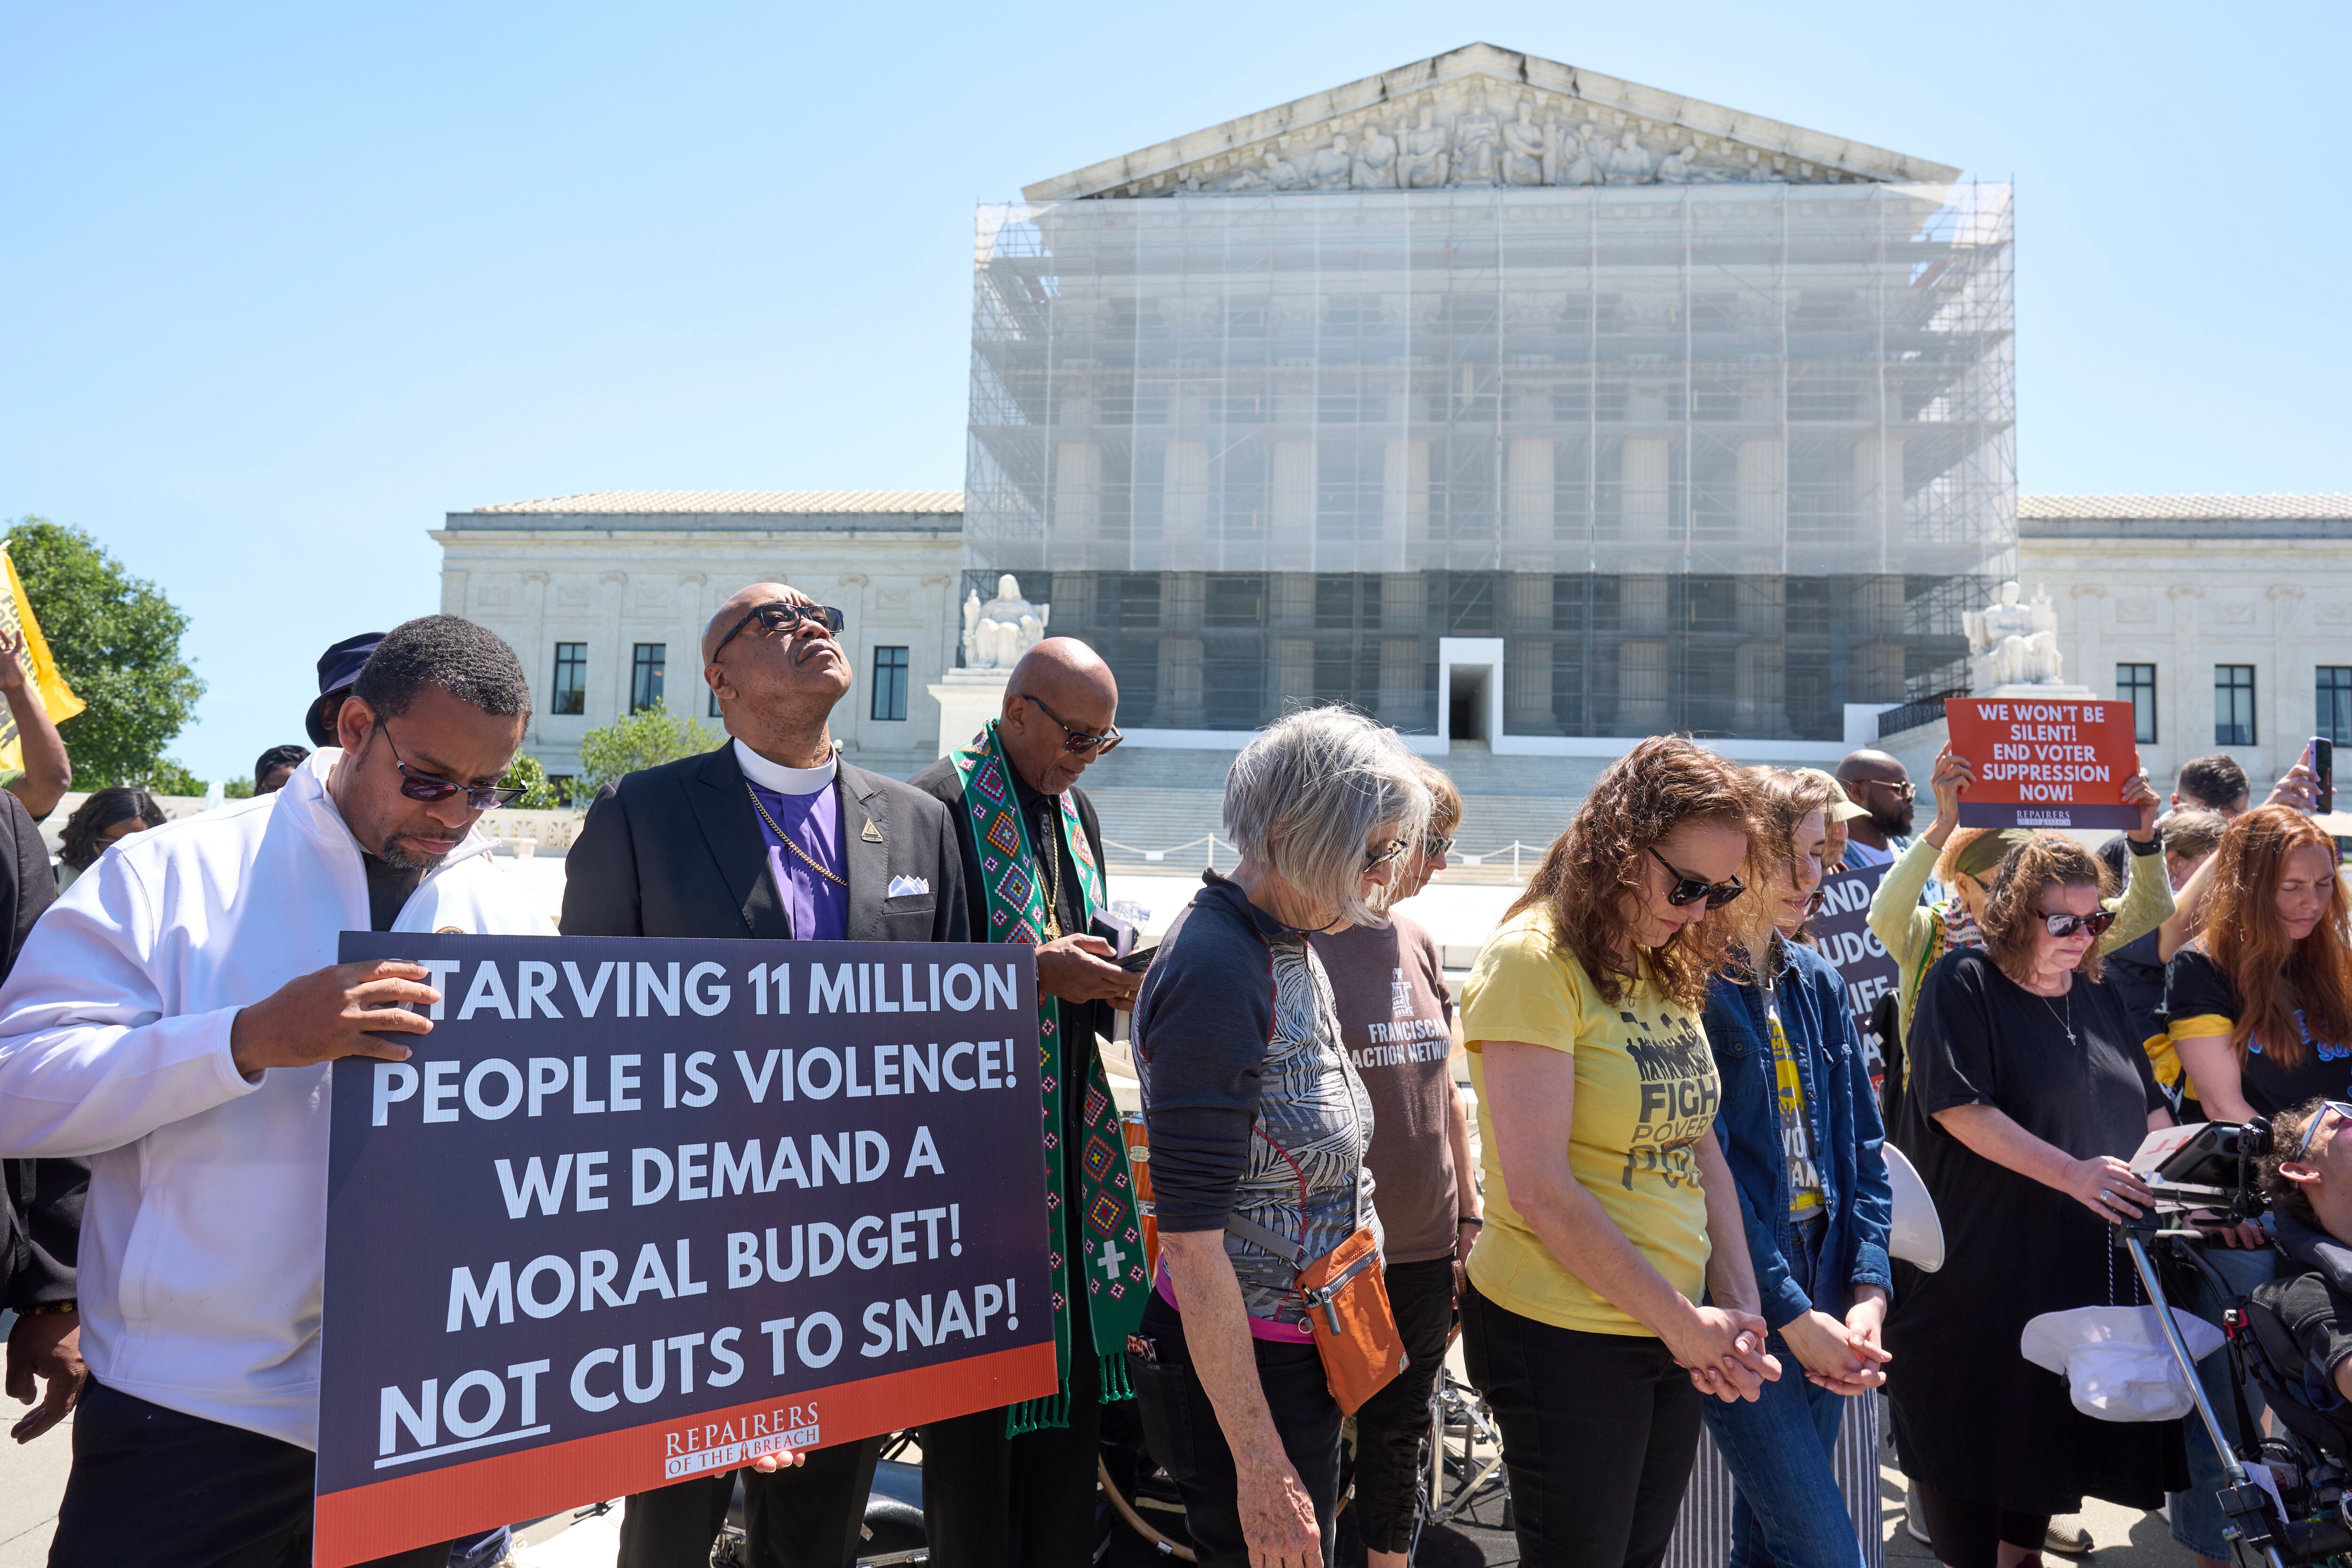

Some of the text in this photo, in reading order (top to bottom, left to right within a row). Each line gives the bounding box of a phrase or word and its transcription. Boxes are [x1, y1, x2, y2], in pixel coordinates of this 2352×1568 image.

[1978, 705, 2104, 722] WE WON'T BE
[2011, 724, 2076, 741] SILENT!
[1983, 764, 2109, 781] SUPPRESSION
[1994, 744, 2096, 761] END VOTER
[2020, 784, 2073, 801] NOW!
[2017, 810, 2070, 819] REPAIRERS
[1810, 927, 1886, 967] UDG
[371, 958, 1017, 1020] TARVING 11 MILLION
[1368, 1019, 1448, 1043] FRANCISCAN
[1351, 1044, 1406, 1068] ACTION
[373, 1039, 1016, 1126] PEOPLE IS VIOLENCE!
[1639, 1076, 1719, 1123] FIGH
[494, 1126, 945, 1219] WE DEMAND A
[446, 1204, 962, 1332] MORAL BUDGET!
[380, 1278, 1018, 1456] NOT CUTS TO SNAP!
[665, 1402, 818, 1457] REPAIRERS
[668, 1428, 816, 1474] OF THE BREACH
